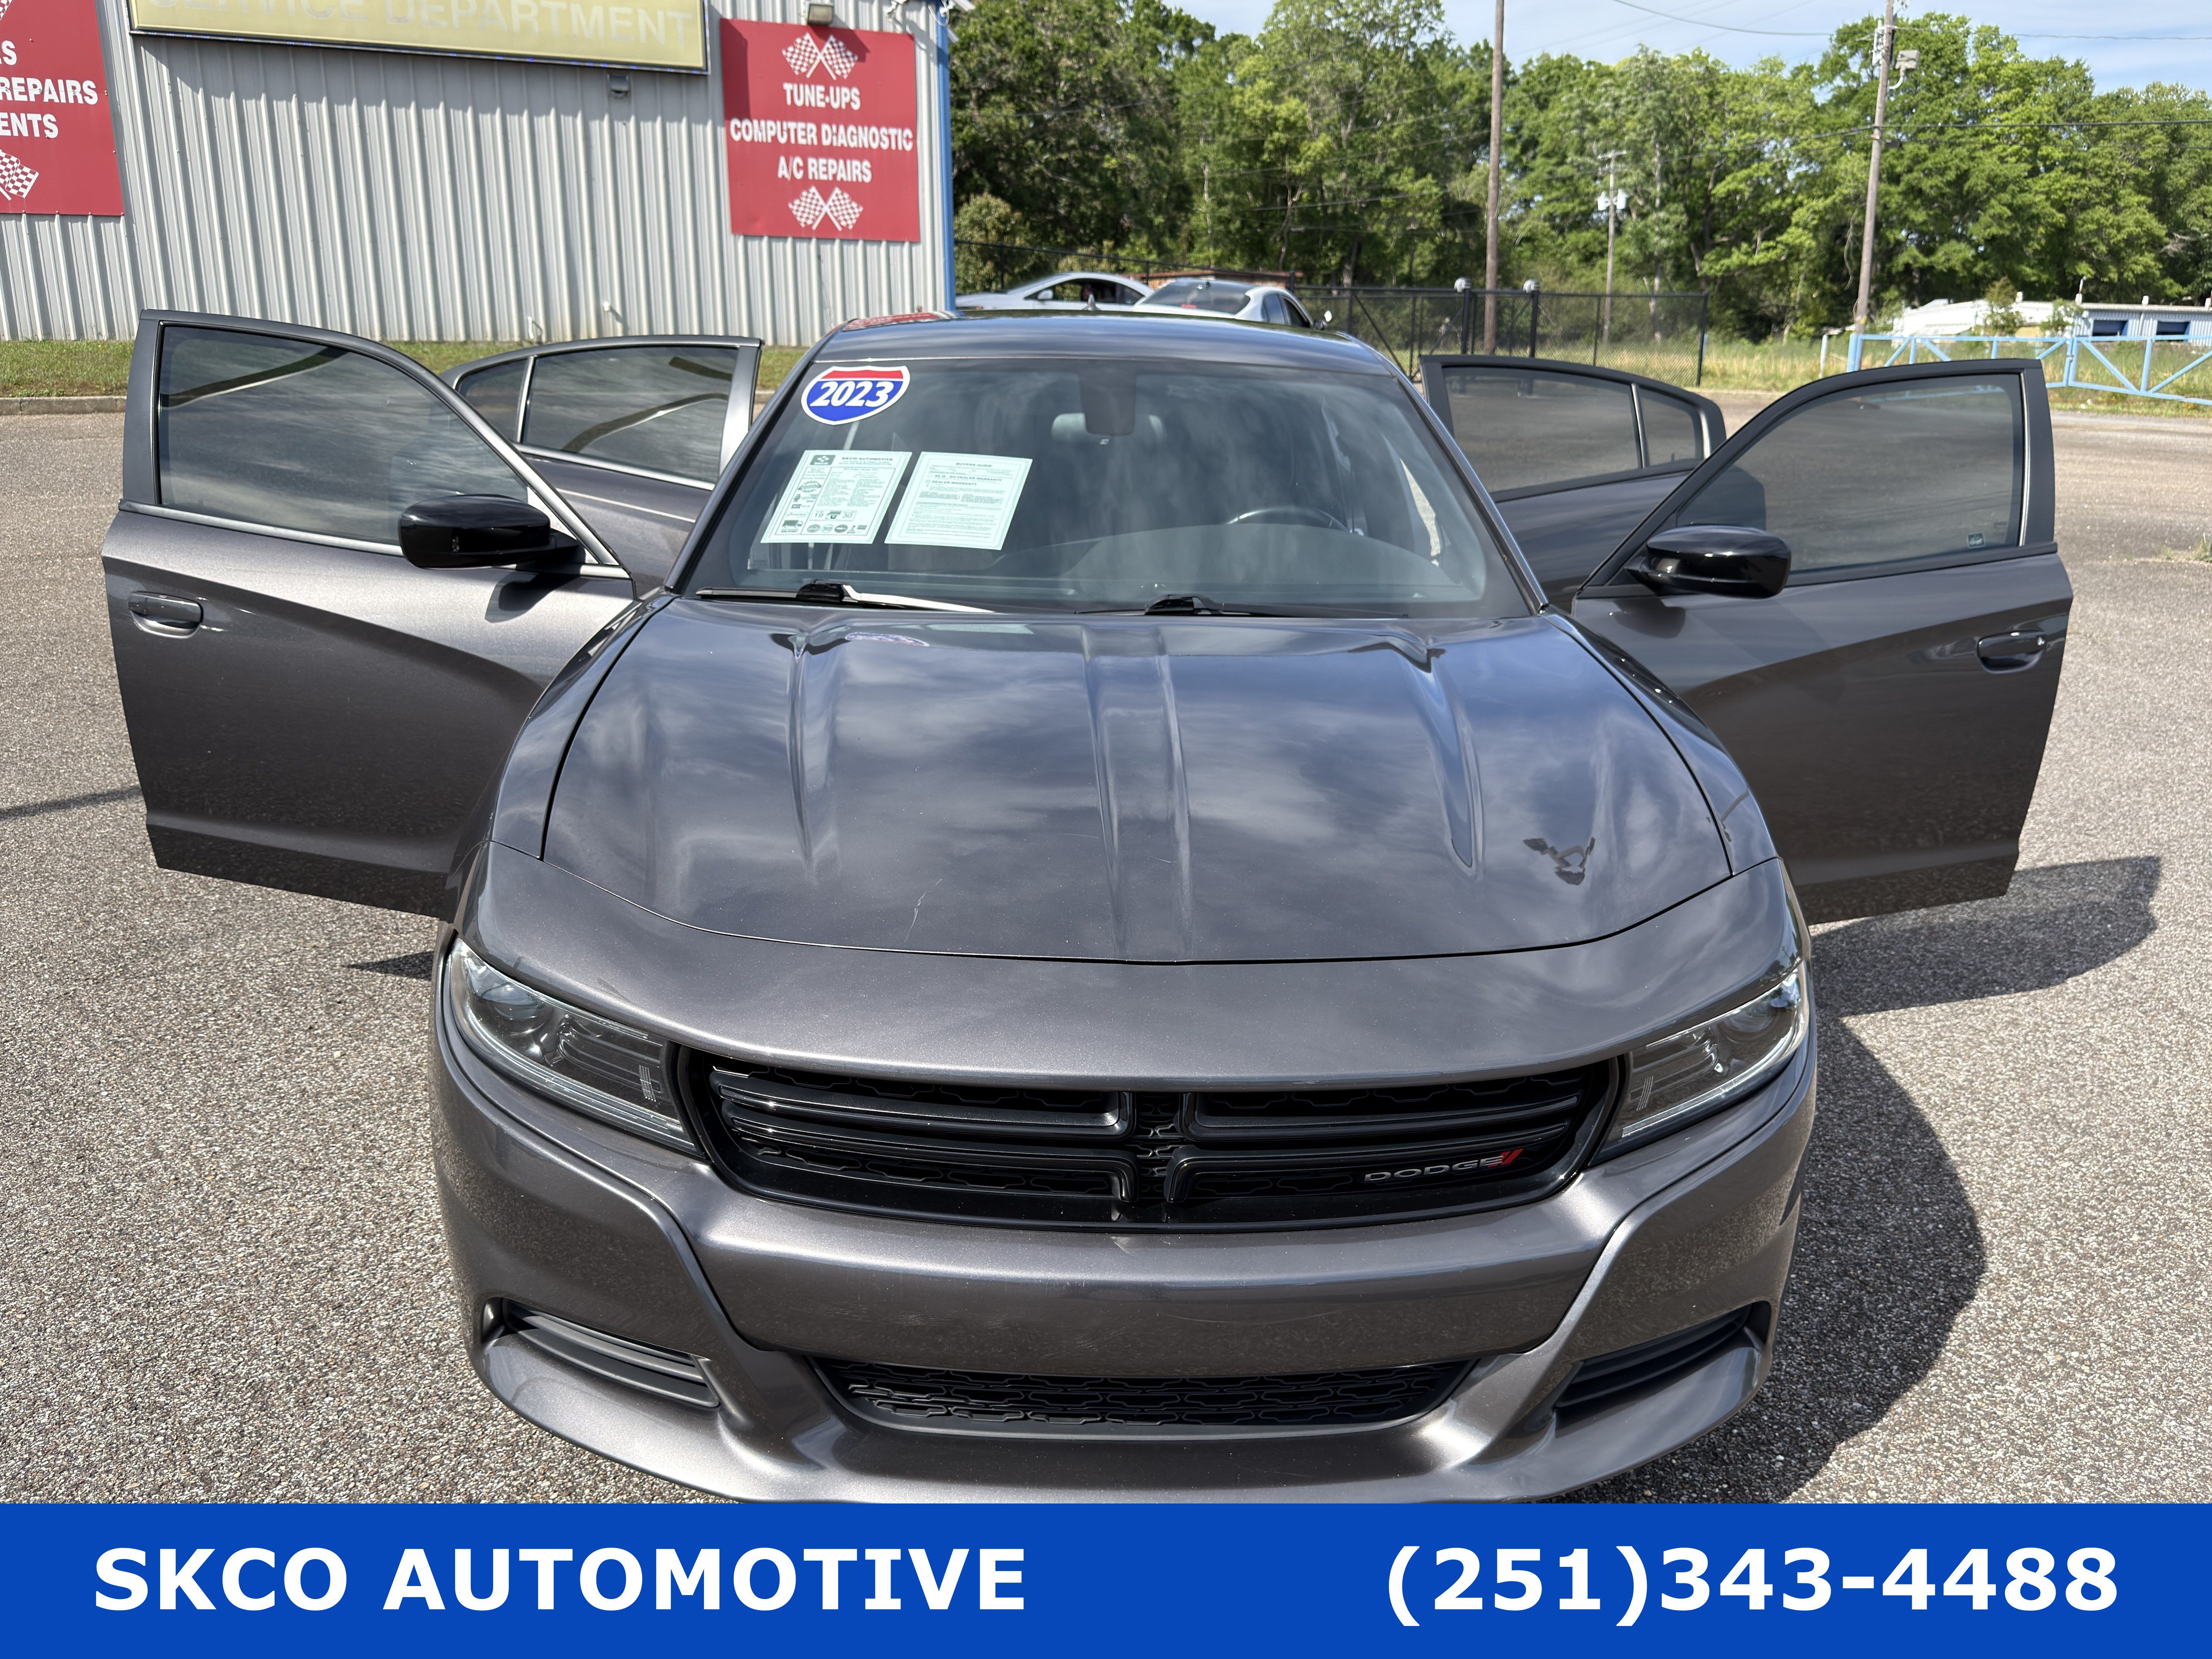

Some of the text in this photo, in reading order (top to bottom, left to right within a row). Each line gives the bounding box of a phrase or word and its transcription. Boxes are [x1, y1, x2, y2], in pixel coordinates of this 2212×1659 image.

[386, 0, 692, 48] DEPARTMENT
[0, 40, 17, 65] S
[0, 76, 98, 105] REPAIRS
[783, 82, 861, 111] TUNE-UPS
[0, 112, 58, 138] ENTS
[730, 118, 913, 151] COMPUTER DIAGNOSTIC
[777, 156, 872, 183] A/C REPAIRS
[810, 381, 894, 407] 2023
[1364, 1155, 1504, 1182] DODGE
